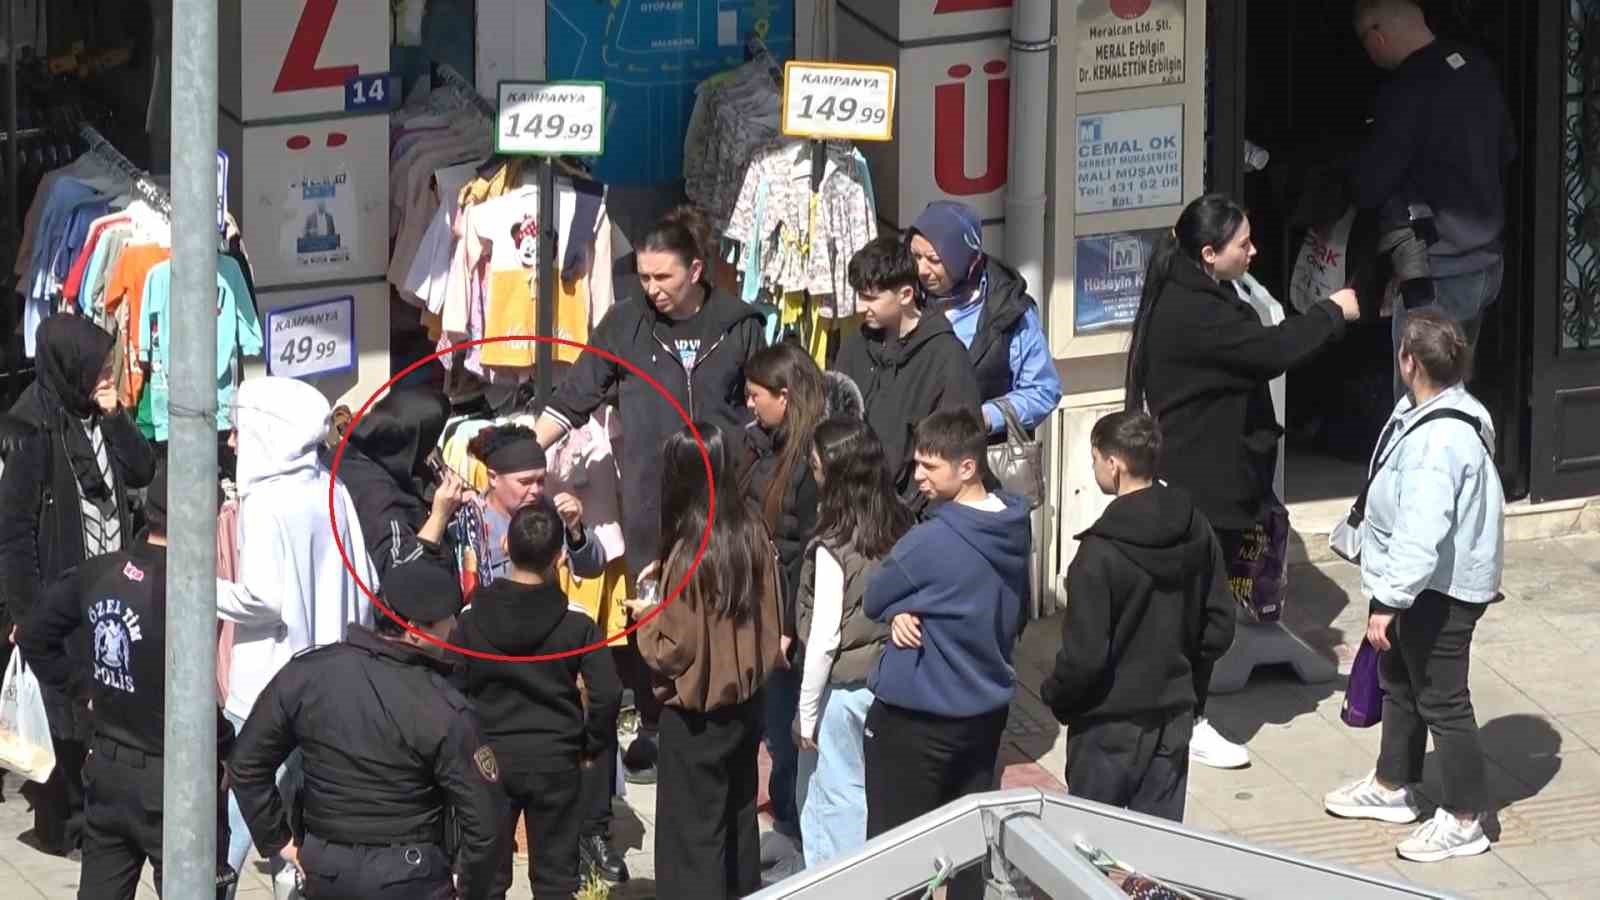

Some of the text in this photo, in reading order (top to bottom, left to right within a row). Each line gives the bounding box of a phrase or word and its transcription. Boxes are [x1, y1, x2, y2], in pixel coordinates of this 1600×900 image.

[1096, 40, 1165, 60] MERAL Erbilgin
[1148, 57, 1182, 74] Erbilgin
[353, 79, 384, 103] 14
[801, 73, 879, 89] KAMPANYA
[507, 92, 586, 103] KAMPANYA
[1078, 136, 1176, 158] CEMAL OK
[275, 312, 338, 332] KAMPANYA
[88, 600, 121, 624] ÖZEL
[94, 662, 135, 693] POLİS
